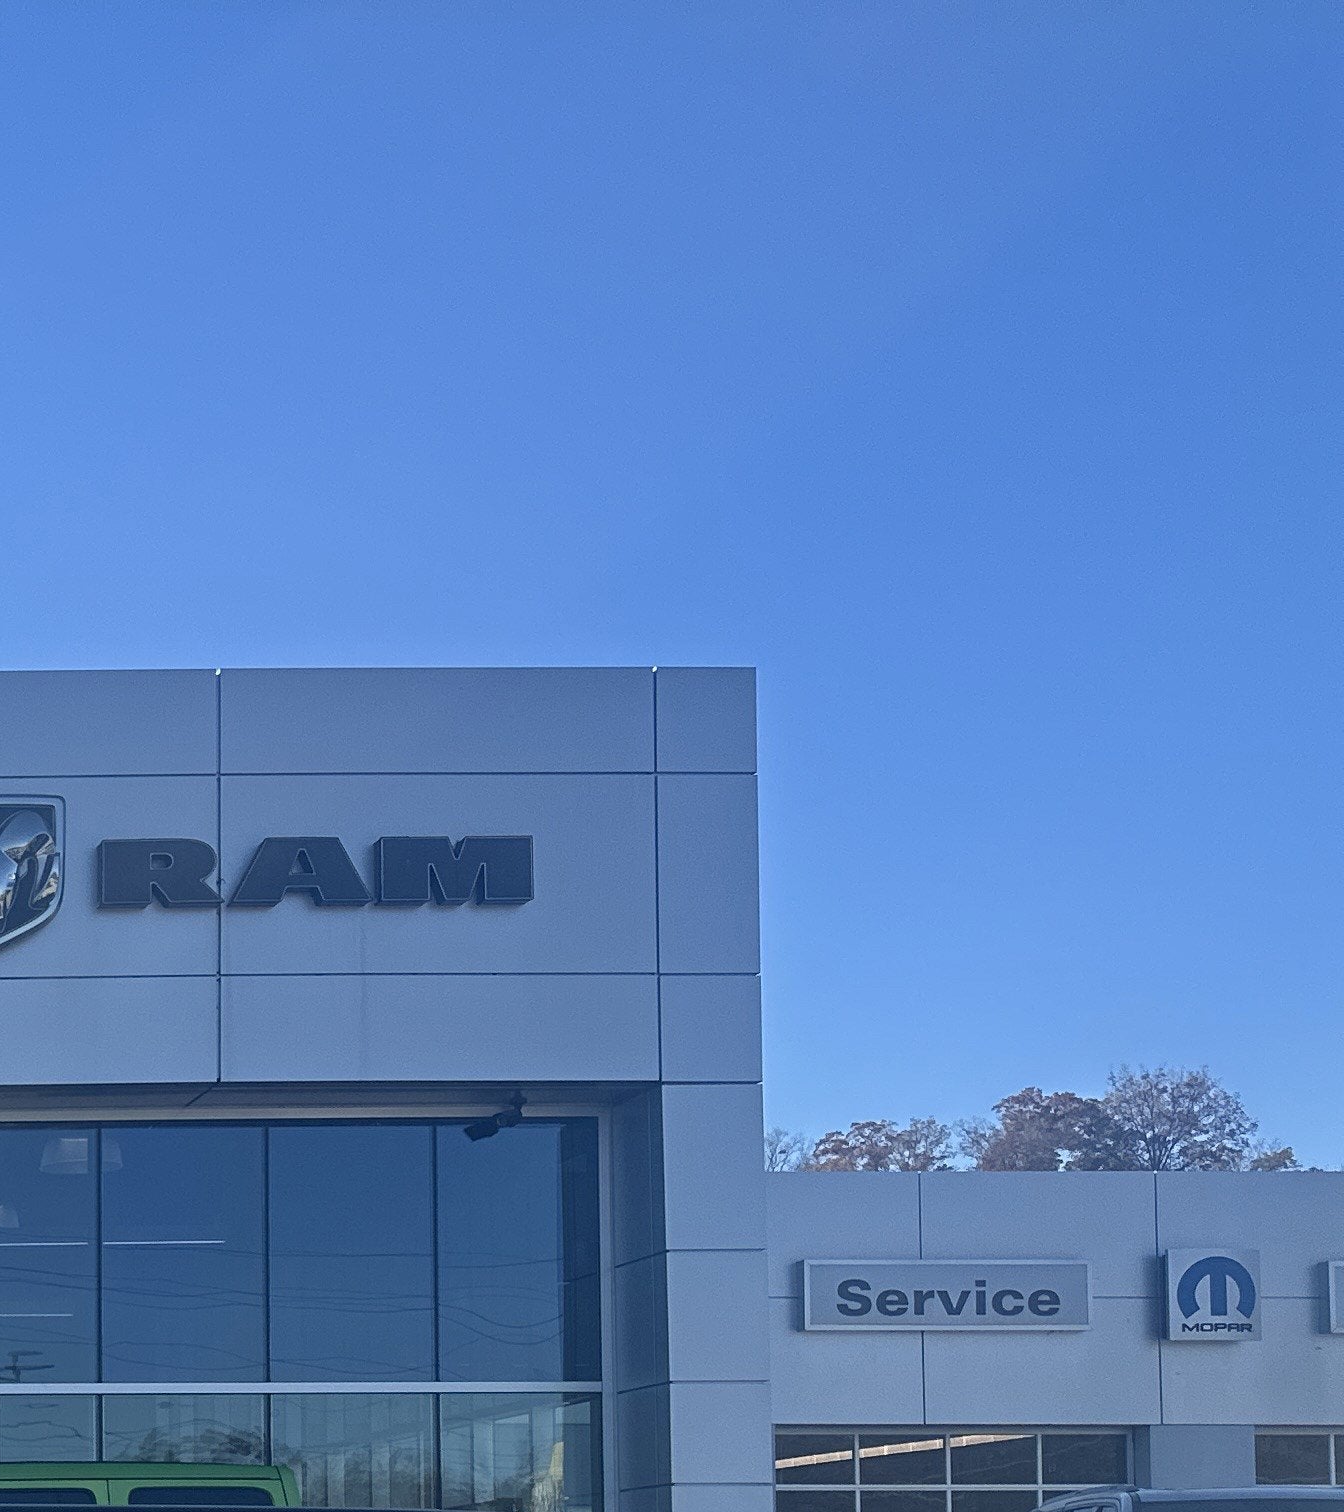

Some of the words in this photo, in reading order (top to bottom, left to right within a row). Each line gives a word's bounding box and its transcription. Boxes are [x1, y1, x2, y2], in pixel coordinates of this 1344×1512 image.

[98, 835, 535, 909] RAM
[836, 1278, 1061, 1317] Service
[1181, 1323, 1253, 1333] MOPAR
